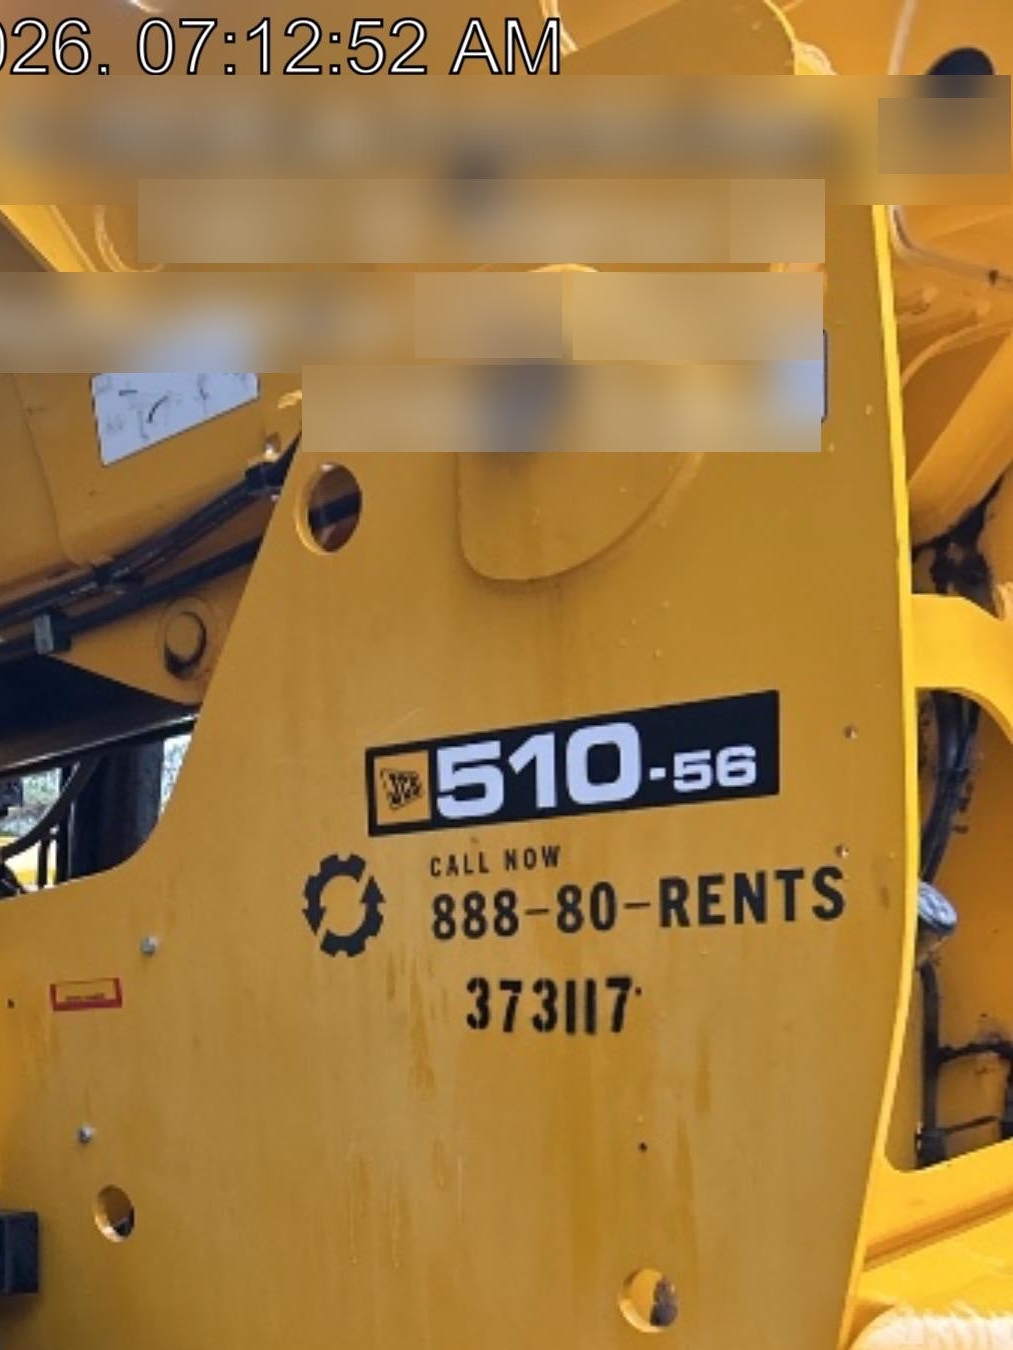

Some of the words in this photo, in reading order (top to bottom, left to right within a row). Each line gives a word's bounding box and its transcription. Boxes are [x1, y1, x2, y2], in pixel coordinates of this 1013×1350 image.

[429, 853, 490, 878] CALL
[504, 845, 562, 870] NOW
[431, 865, 846, 940] 888-80-RENTS
[465, 976, 633, 1035] 373117
